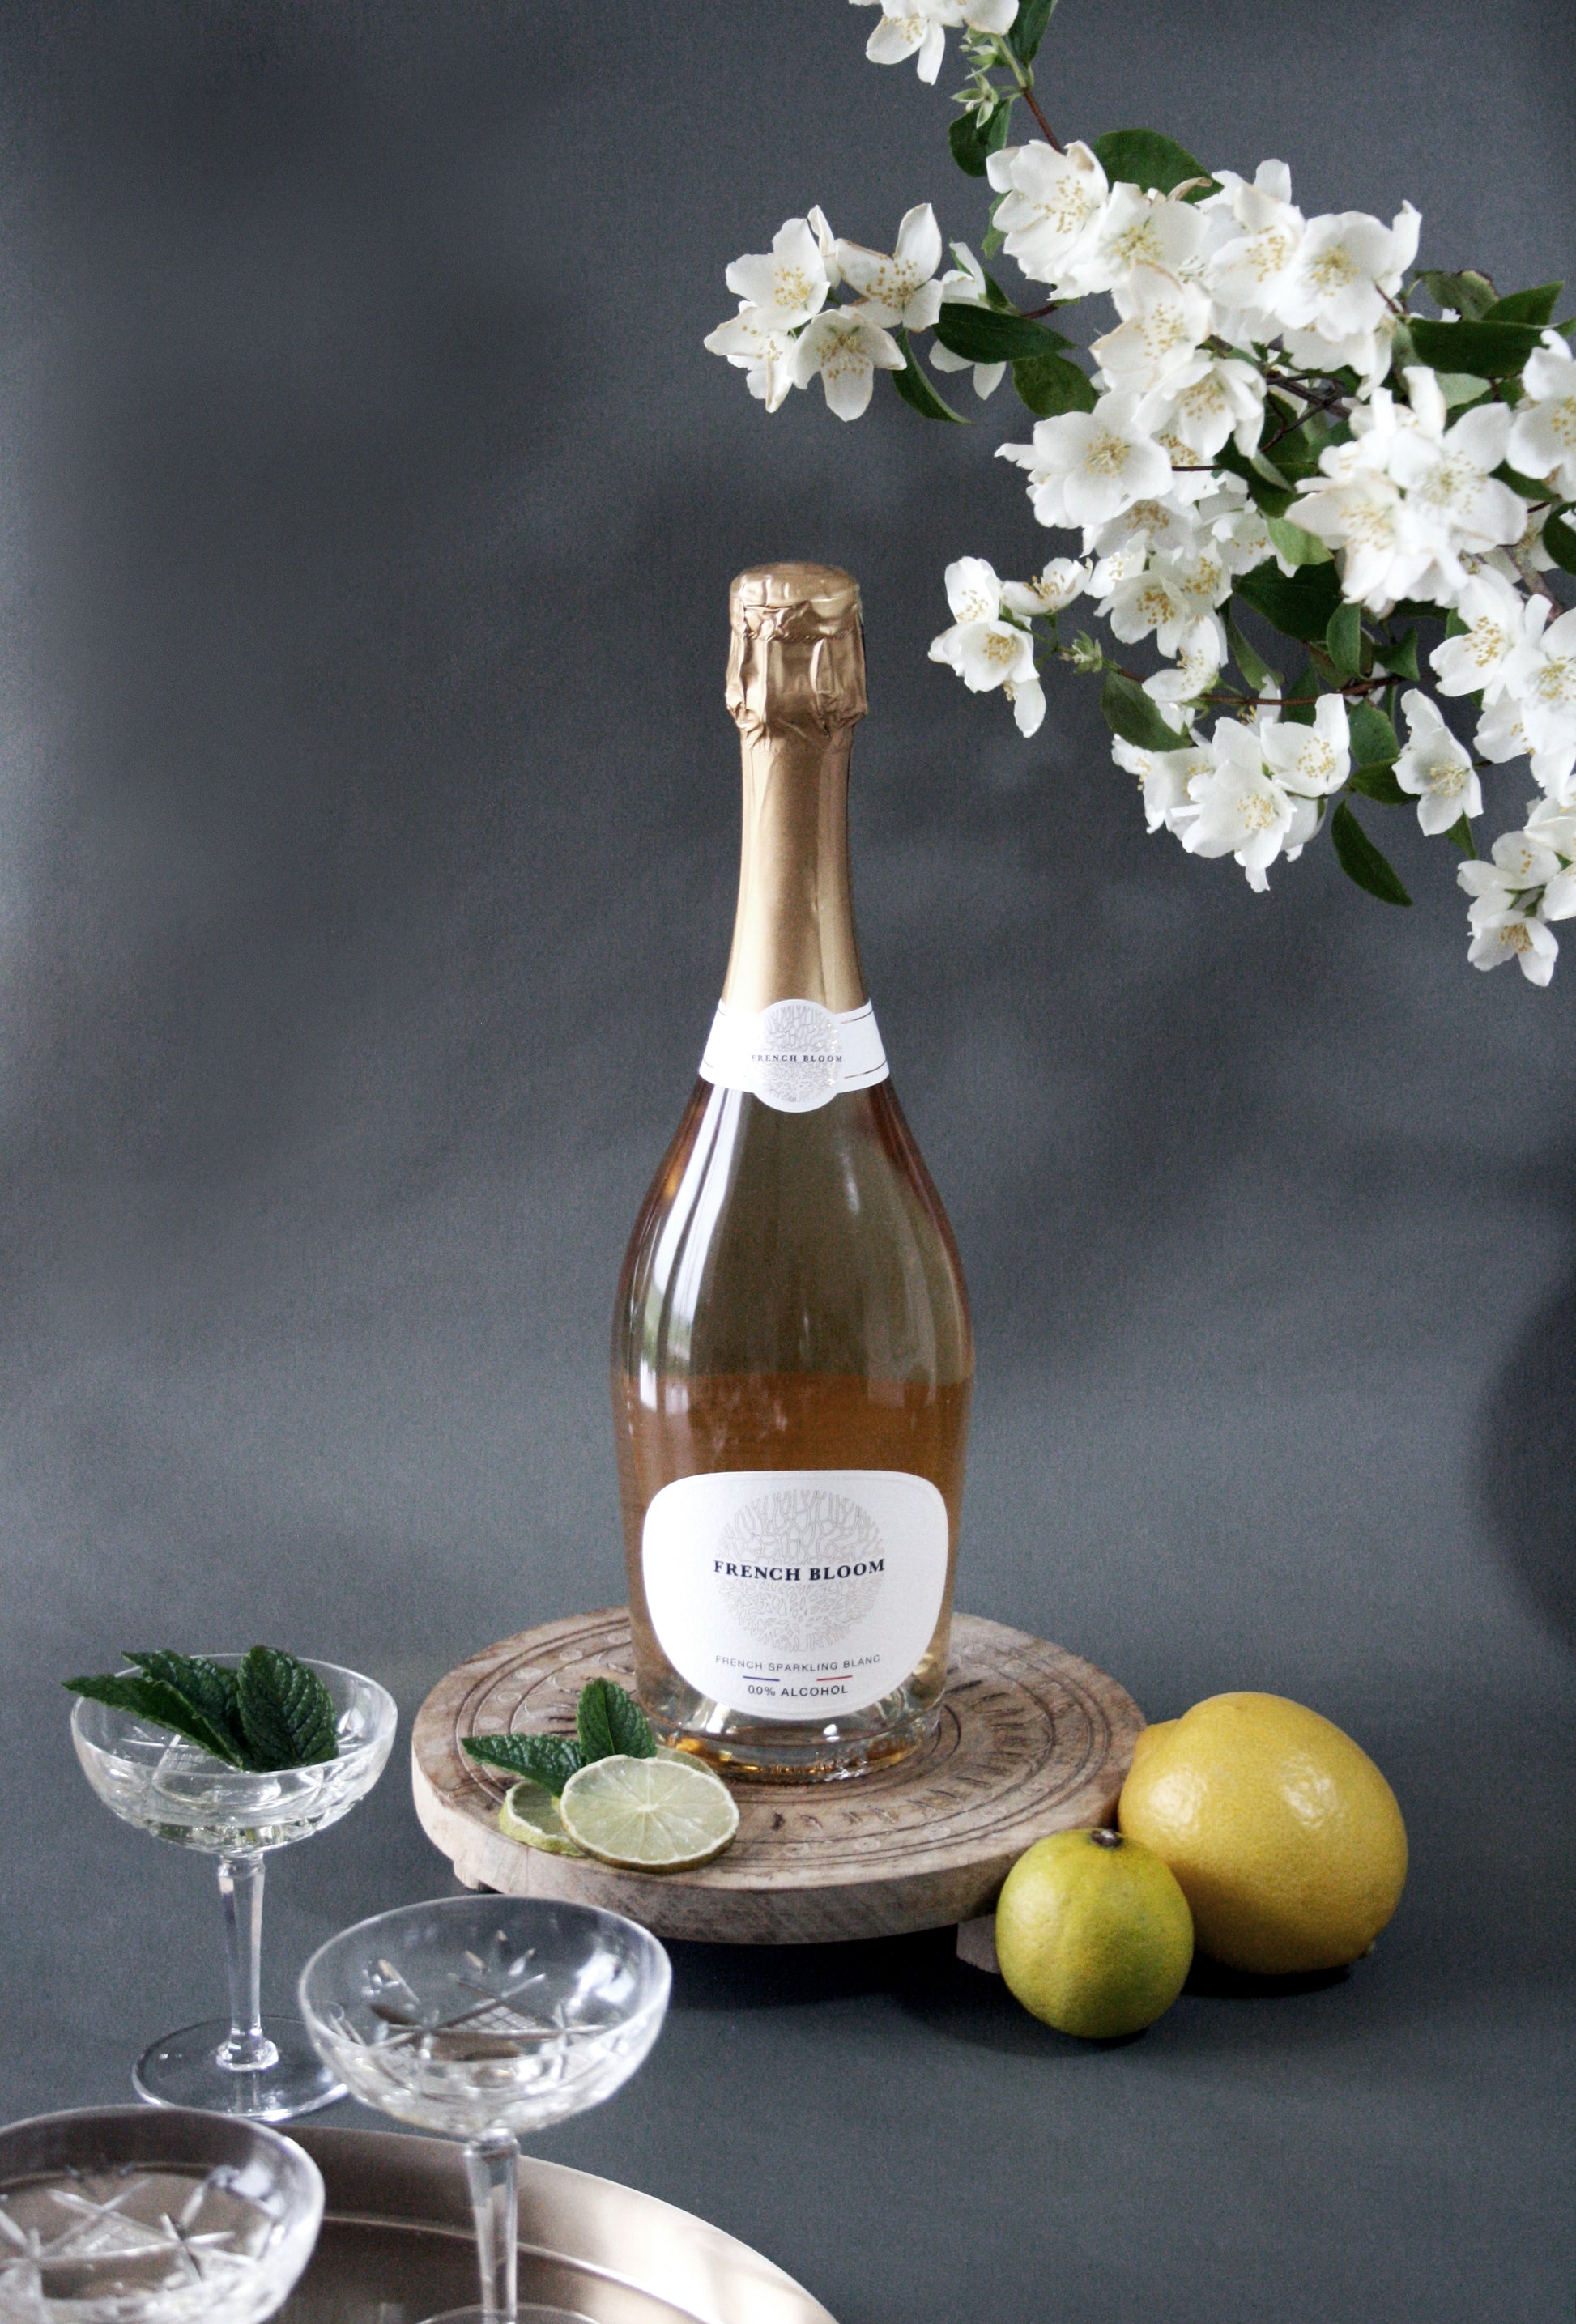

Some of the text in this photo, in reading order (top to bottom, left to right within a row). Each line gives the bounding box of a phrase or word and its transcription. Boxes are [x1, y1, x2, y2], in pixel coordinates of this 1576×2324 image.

[752, 1054, 842, 1062] FRENCH BLOOM
[713, 1558, 885, 1581] FRENCH BLOOM
[715, 1654, 880, 1671] FRENCH SPARKLING BLANC
[781, 1685, 848, 1696] ALCOHOL
